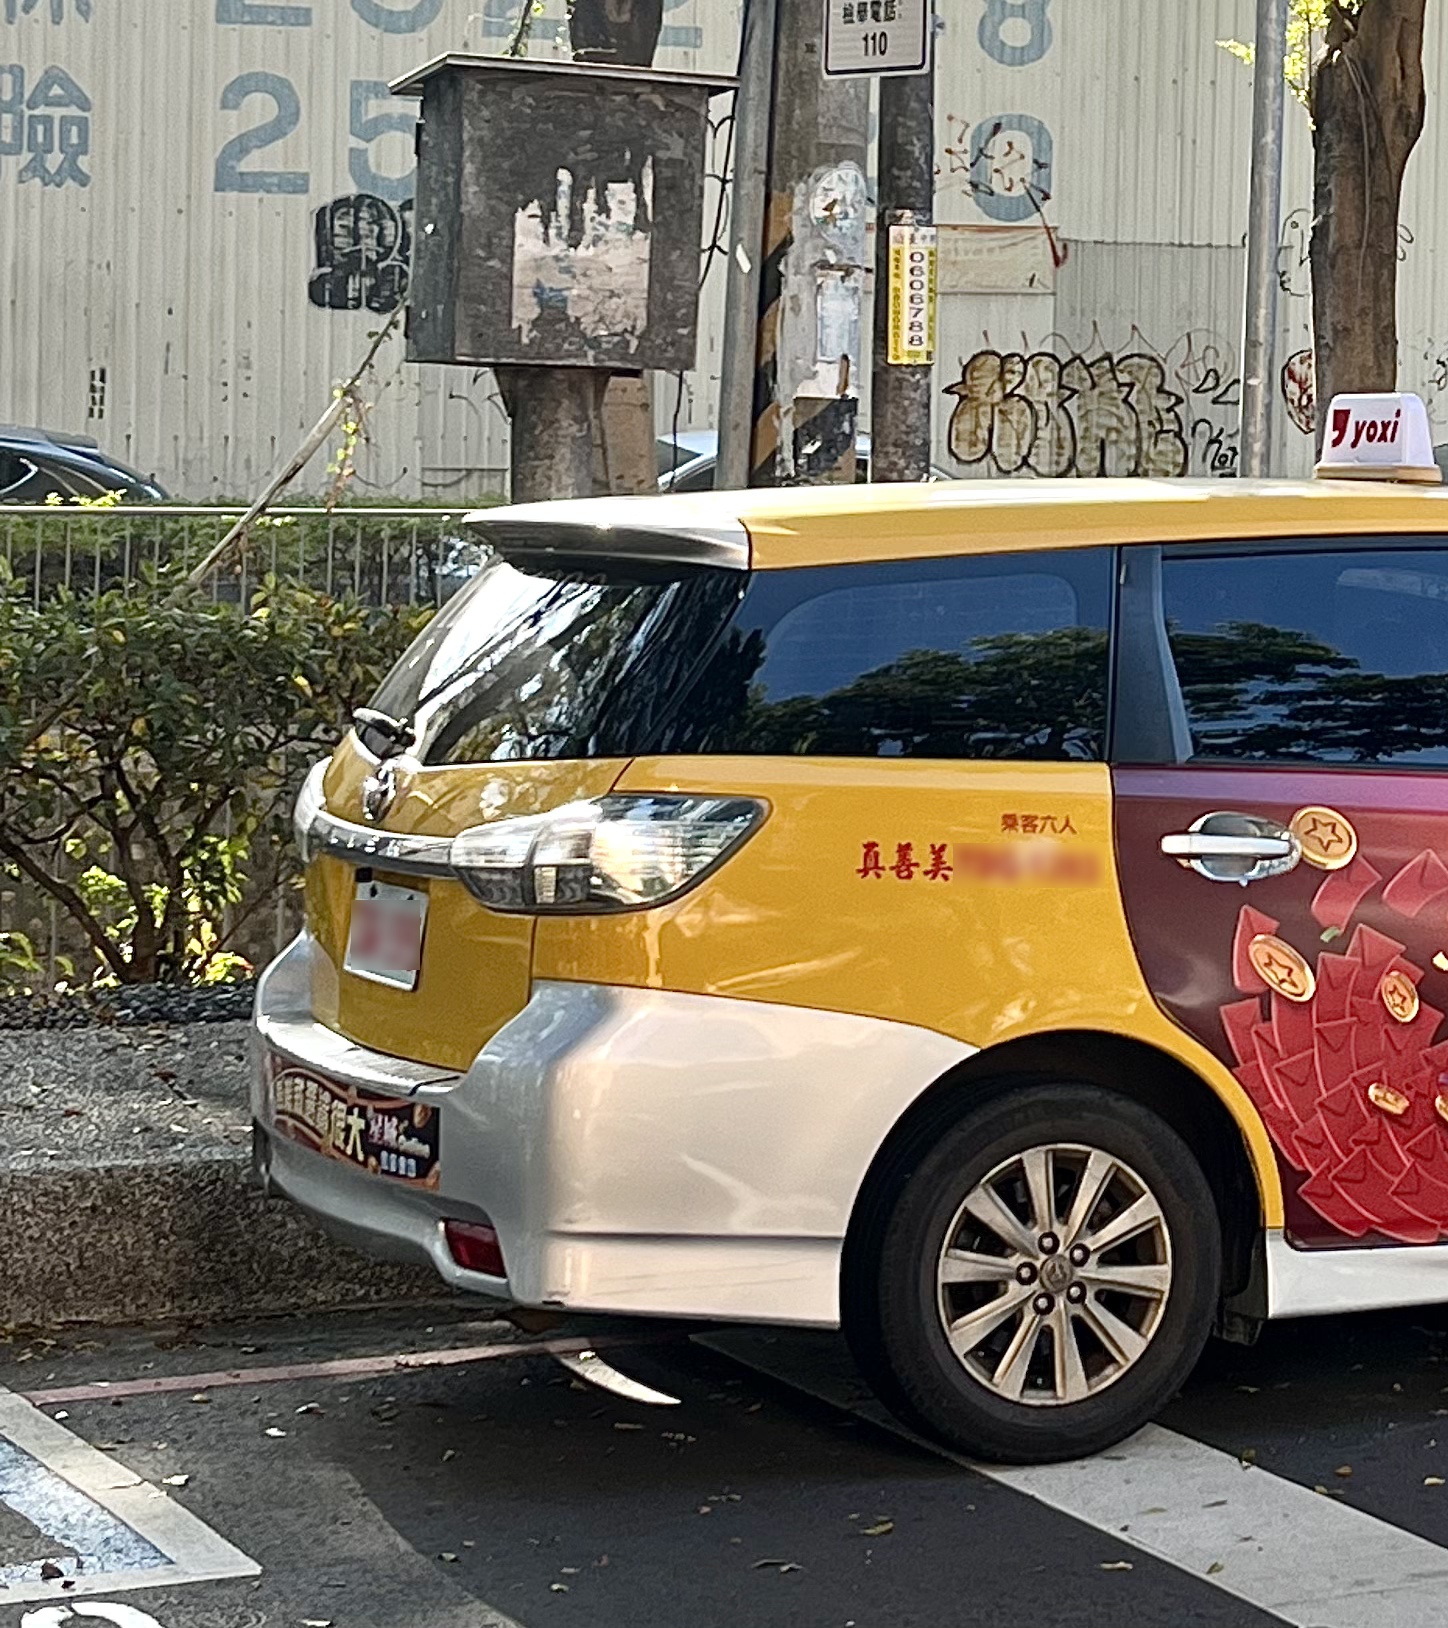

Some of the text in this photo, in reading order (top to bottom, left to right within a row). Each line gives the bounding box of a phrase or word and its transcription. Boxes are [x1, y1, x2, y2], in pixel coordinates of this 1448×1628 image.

[862, 31, 888, 56] 110
[1351, 409, 1401, 449] yoxi
[1001, 813, 1078, 835] 乘客六人
[855, 841, 954, 882] 真善美
